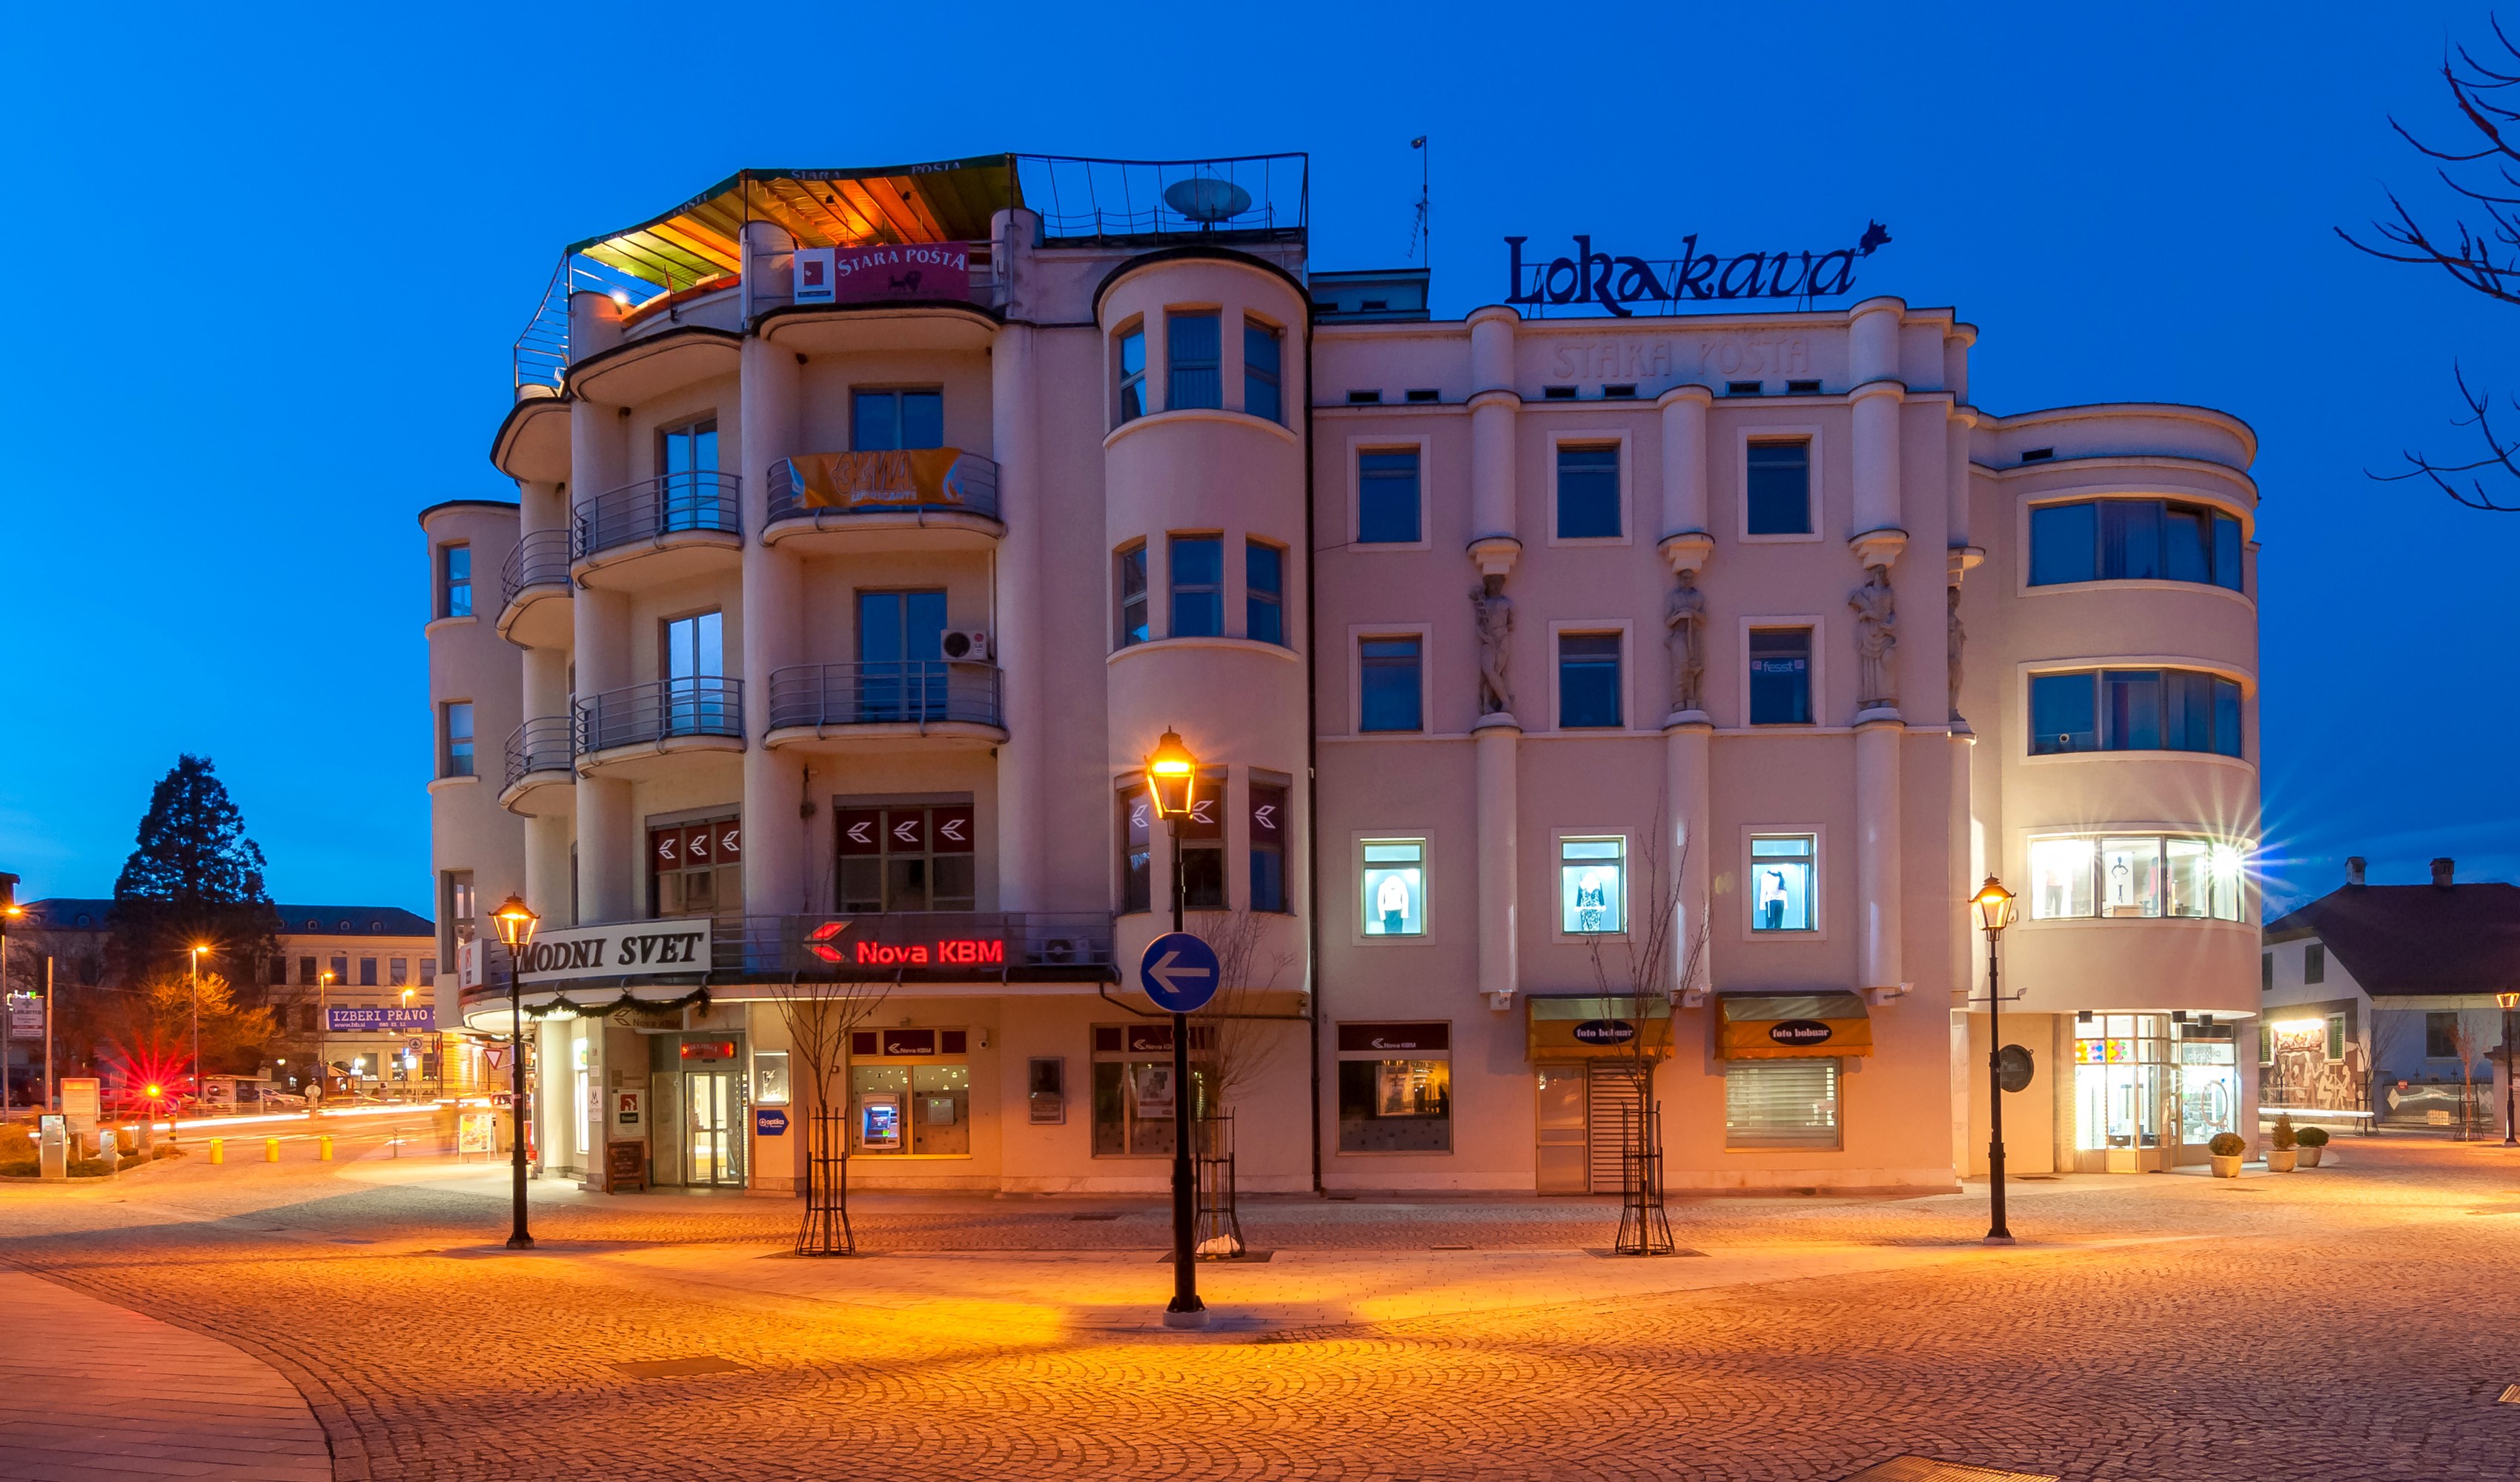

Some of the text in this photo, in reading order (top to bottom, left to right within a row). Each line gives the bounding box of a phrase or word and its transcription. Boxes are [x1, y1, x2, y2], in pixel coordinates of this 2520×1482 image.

[837, 247, 966, 277] STARA POŠTA
[1504, 233, 1857, 317] Loka kava
[517, 931, 705, 974] MODNI SVET
[856, 940, 1004, 963] Nova KBM
[334, 1011, 381, 1021] IZBERI
[387, 1010, 428, 1020] PRAVO
[633, 1018, 656, 1027] Nova
[1576, 1029, 1596, 1037] foto
[1772, 1029, 1829, 1037] foto bobnar
